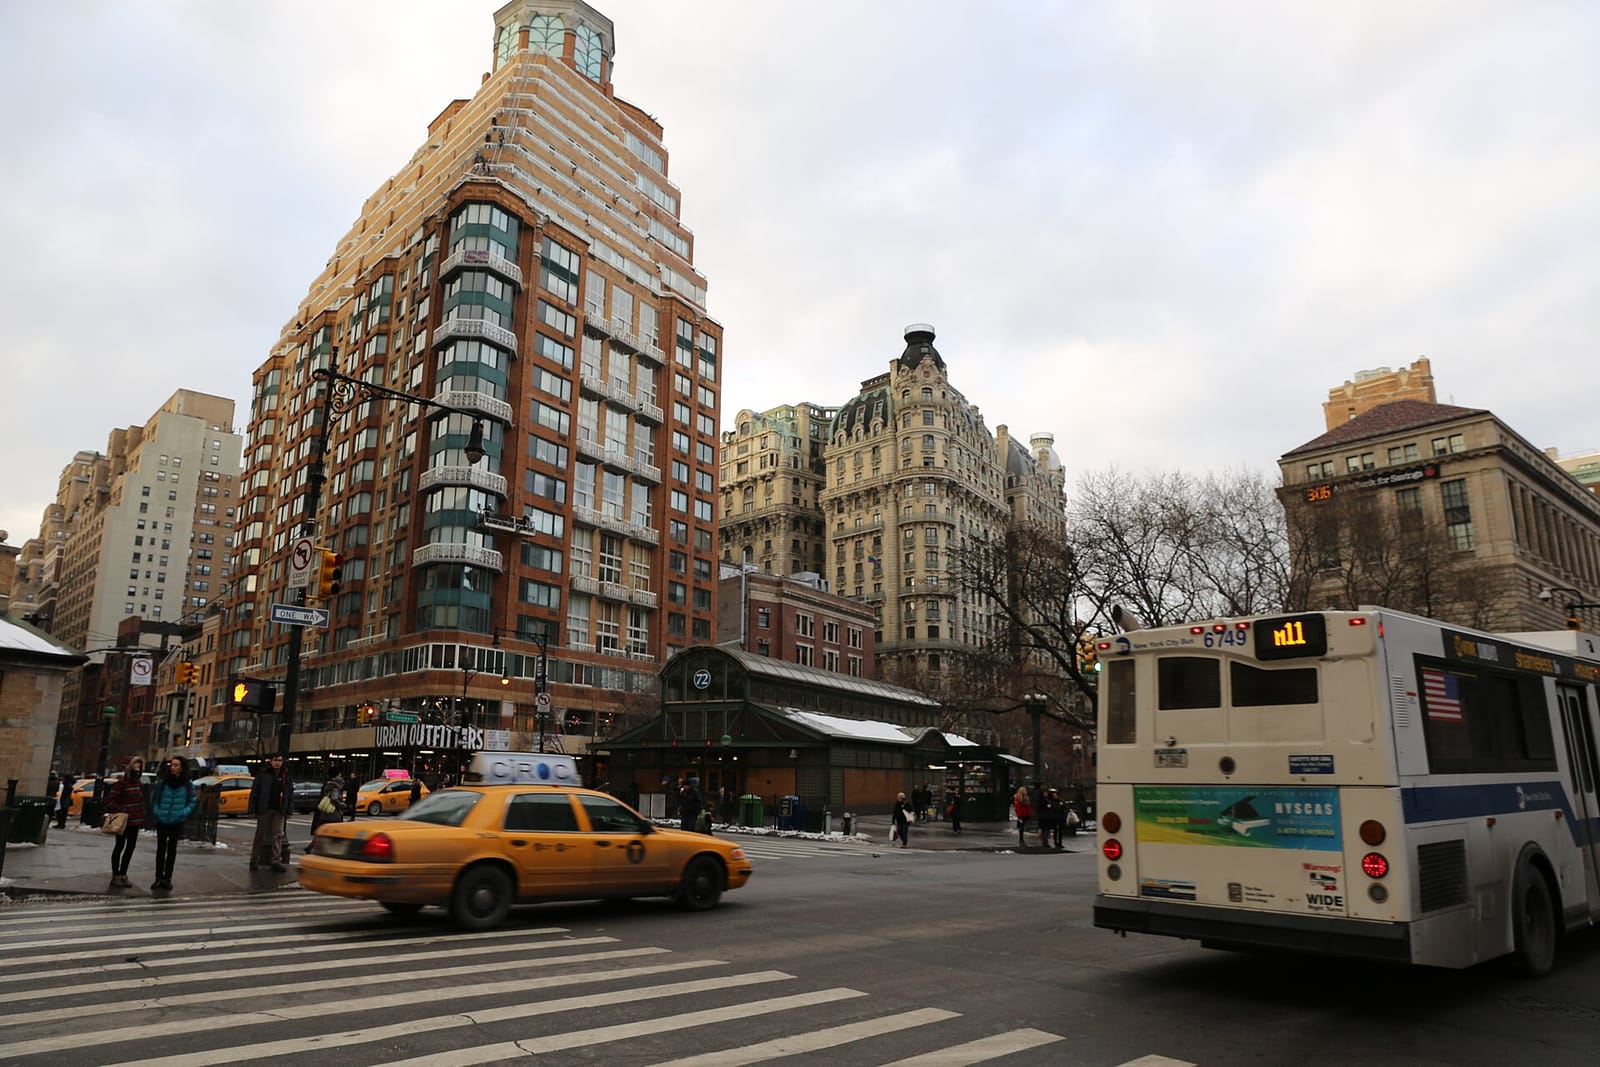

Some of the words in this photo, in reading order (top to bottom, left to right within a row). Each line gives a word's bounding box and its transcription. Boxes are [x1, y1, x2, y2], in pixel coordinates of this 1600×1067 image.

[280, 610, 297, 619] ONE
[303, 612, 320, 620] WAY
[1164, 639, 1180, 647] City
[1203, 630, 1247, 648] 6749
[696, 673, 708, 685] 72
[376, 724, 409, 748] URBAN
[1275, 802, 1333, 815] NYSCAS
[1305, 893, 1344, 907] WIDE
